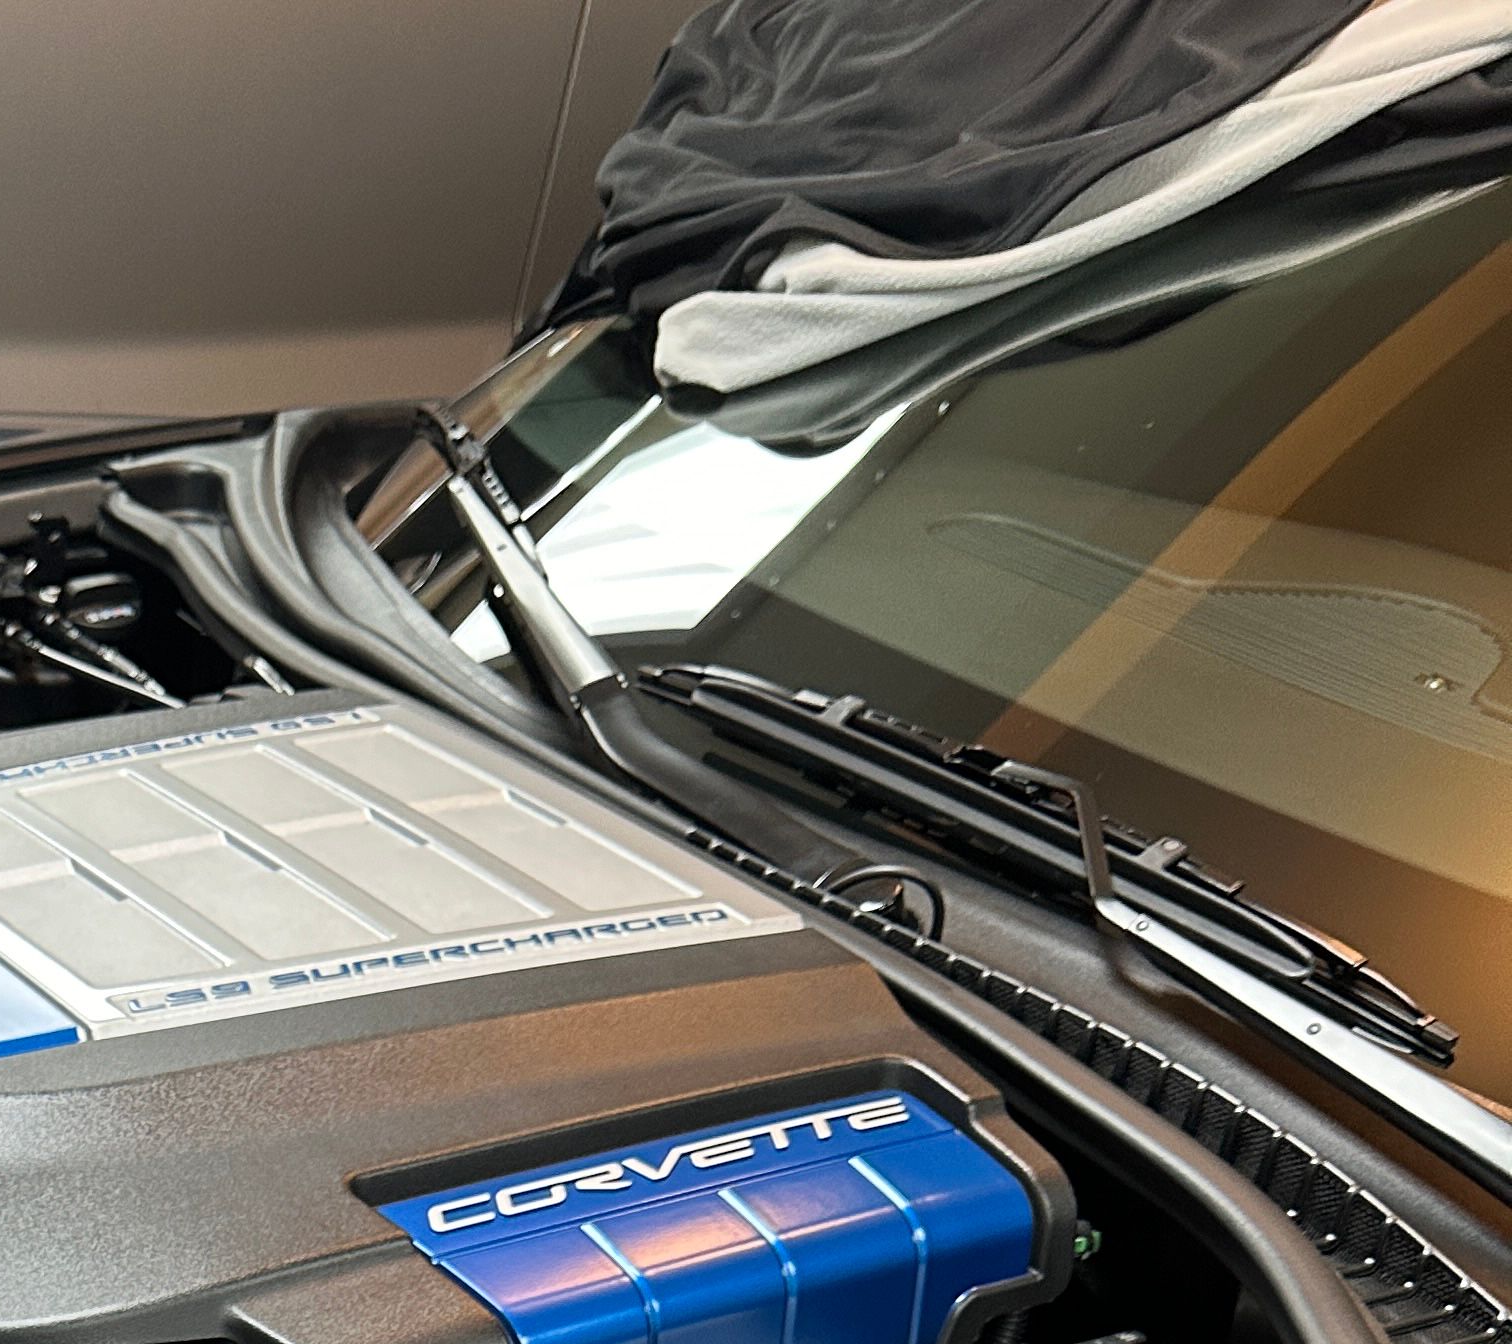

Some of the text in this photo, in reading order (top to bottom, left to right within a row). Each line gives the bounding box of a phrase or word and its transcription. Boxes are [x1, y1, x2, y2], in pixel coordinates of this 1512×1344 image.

[127, 907, 729, 1014] LS9 SUPERCHARGED
[427, 1096, 910, 1234] CORVETTE
